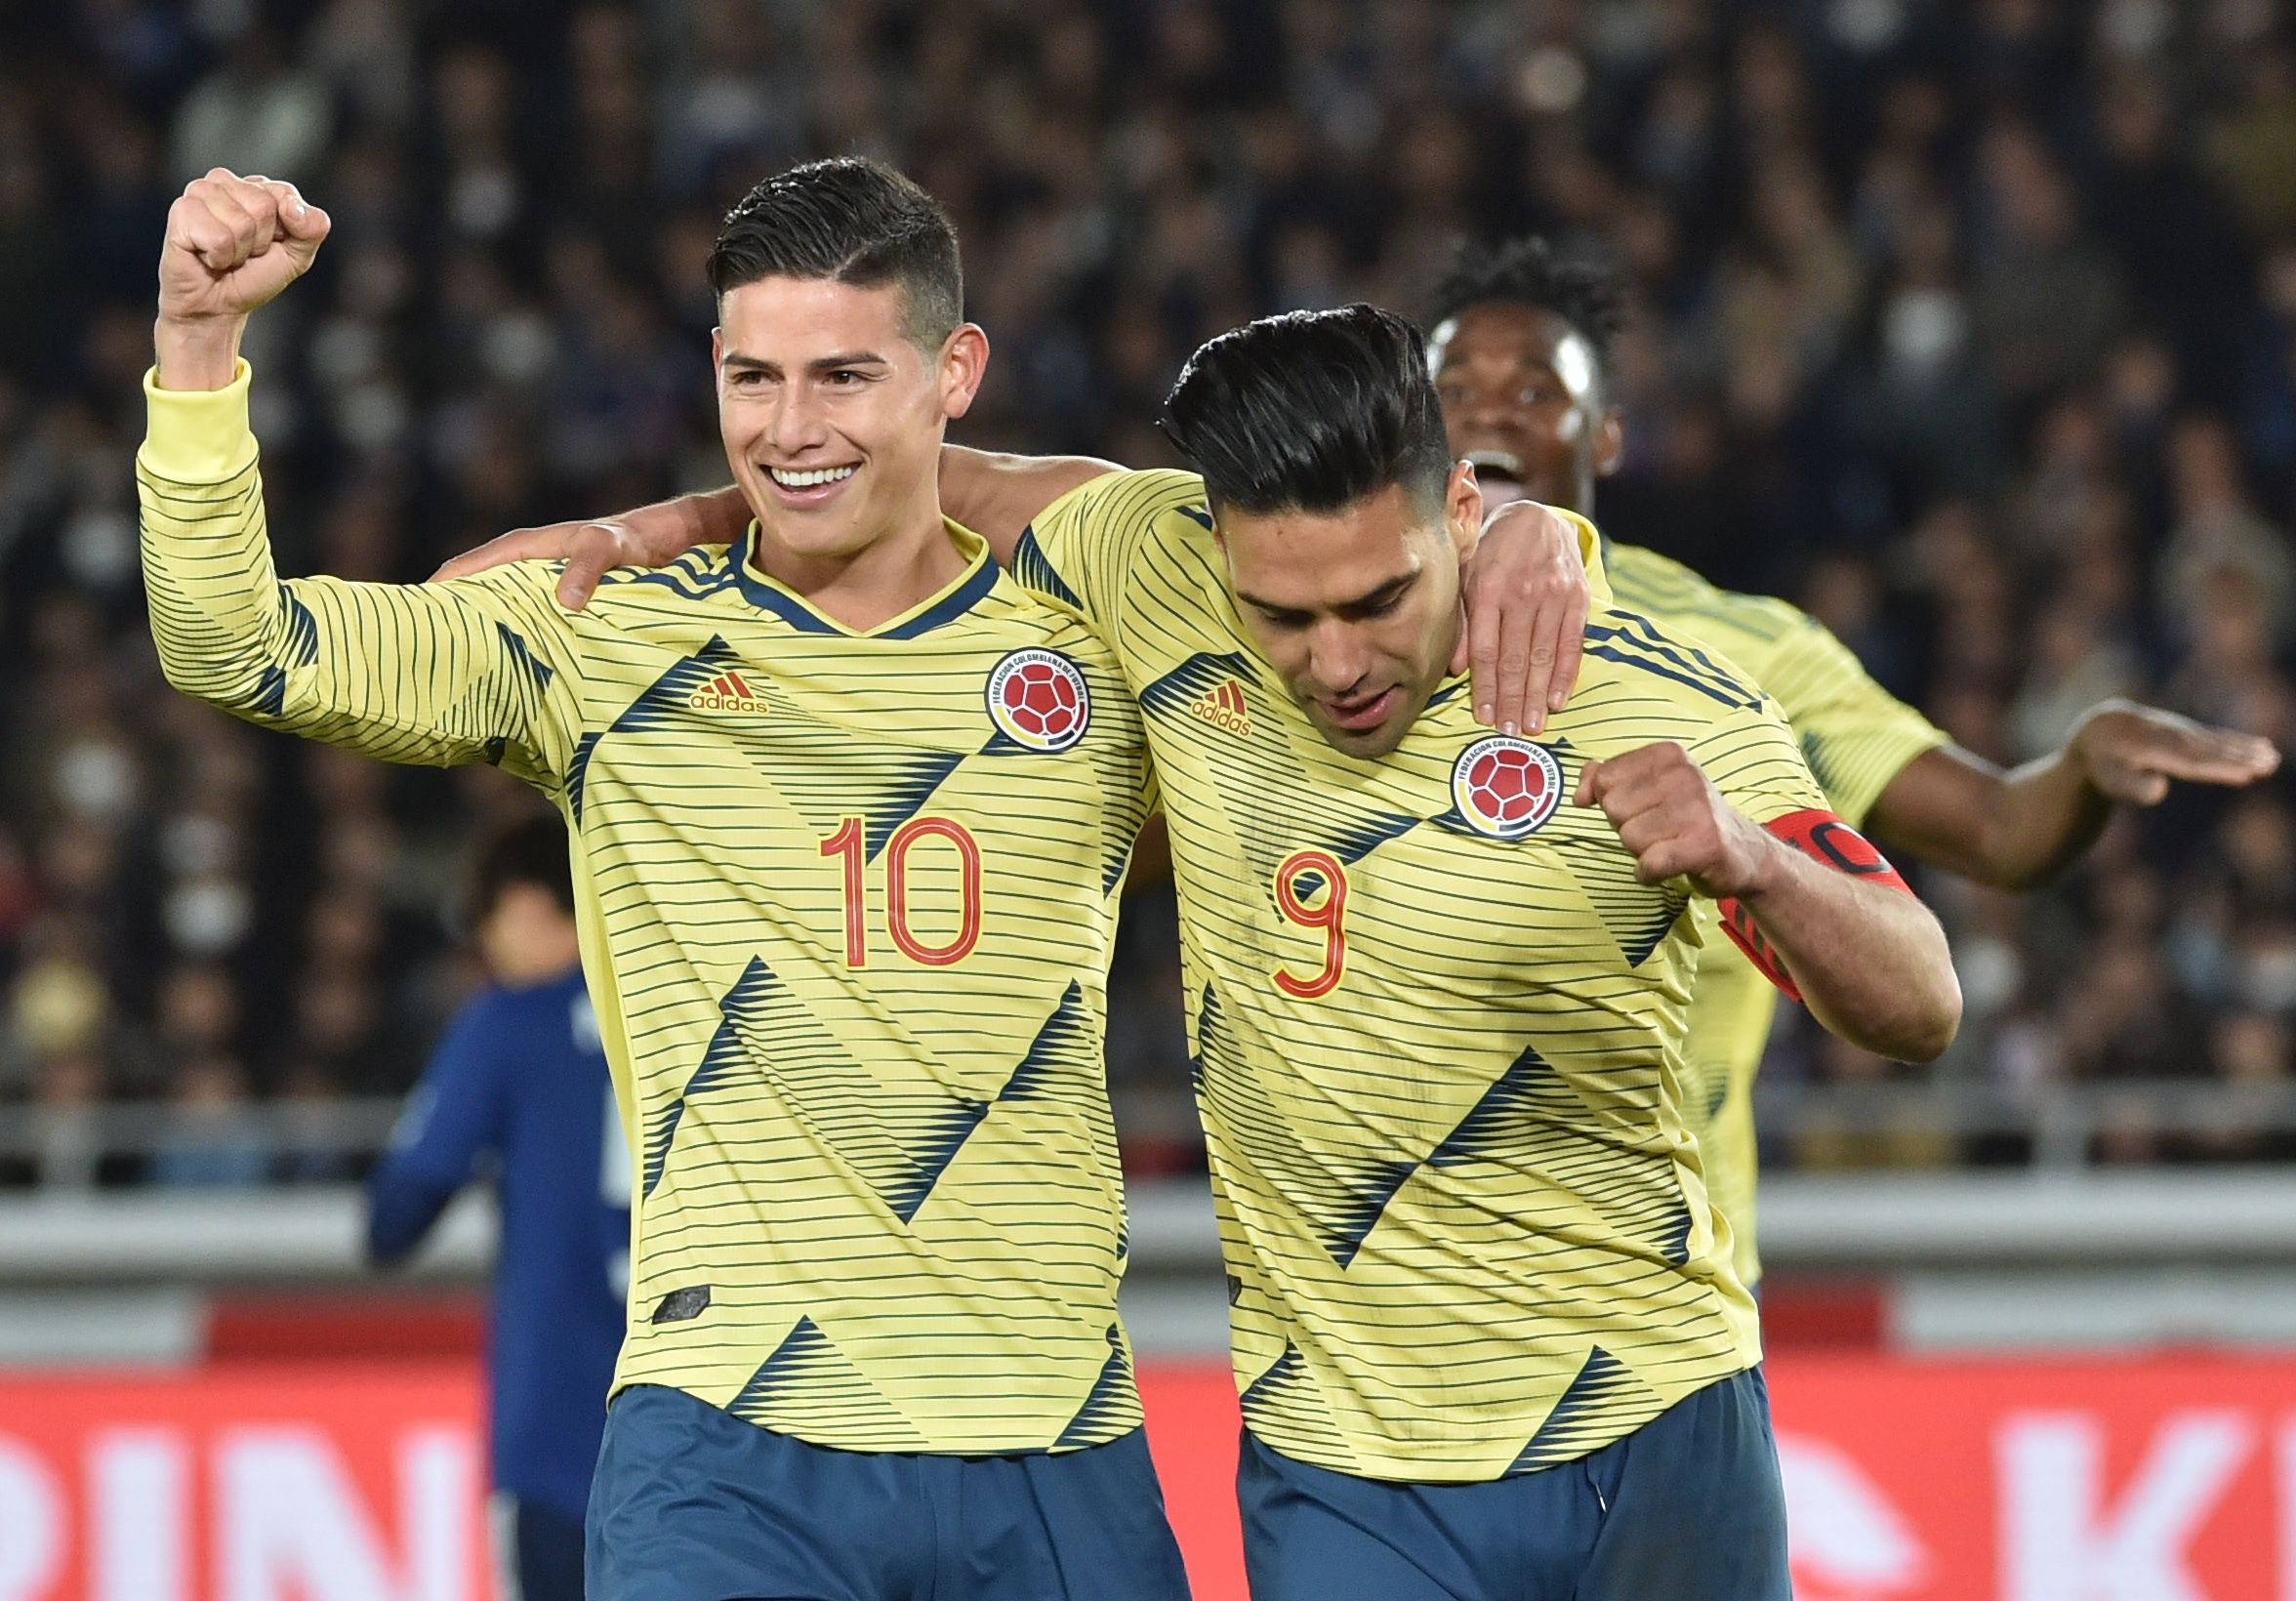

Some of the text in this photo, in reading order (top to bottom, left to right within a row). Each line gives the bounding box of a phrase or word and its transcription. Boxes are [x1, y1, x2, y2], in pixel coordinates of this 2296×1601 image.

[690, 694, 767, 713] adidas
[1191, 701, 1251, 736] adidas
[1457, 742, 1493, 780] FEDERACION
[1810, 821, 1892, 874] C
[819, 816, 980, 967] 10
[1272, 848, 1348, 999] 9
